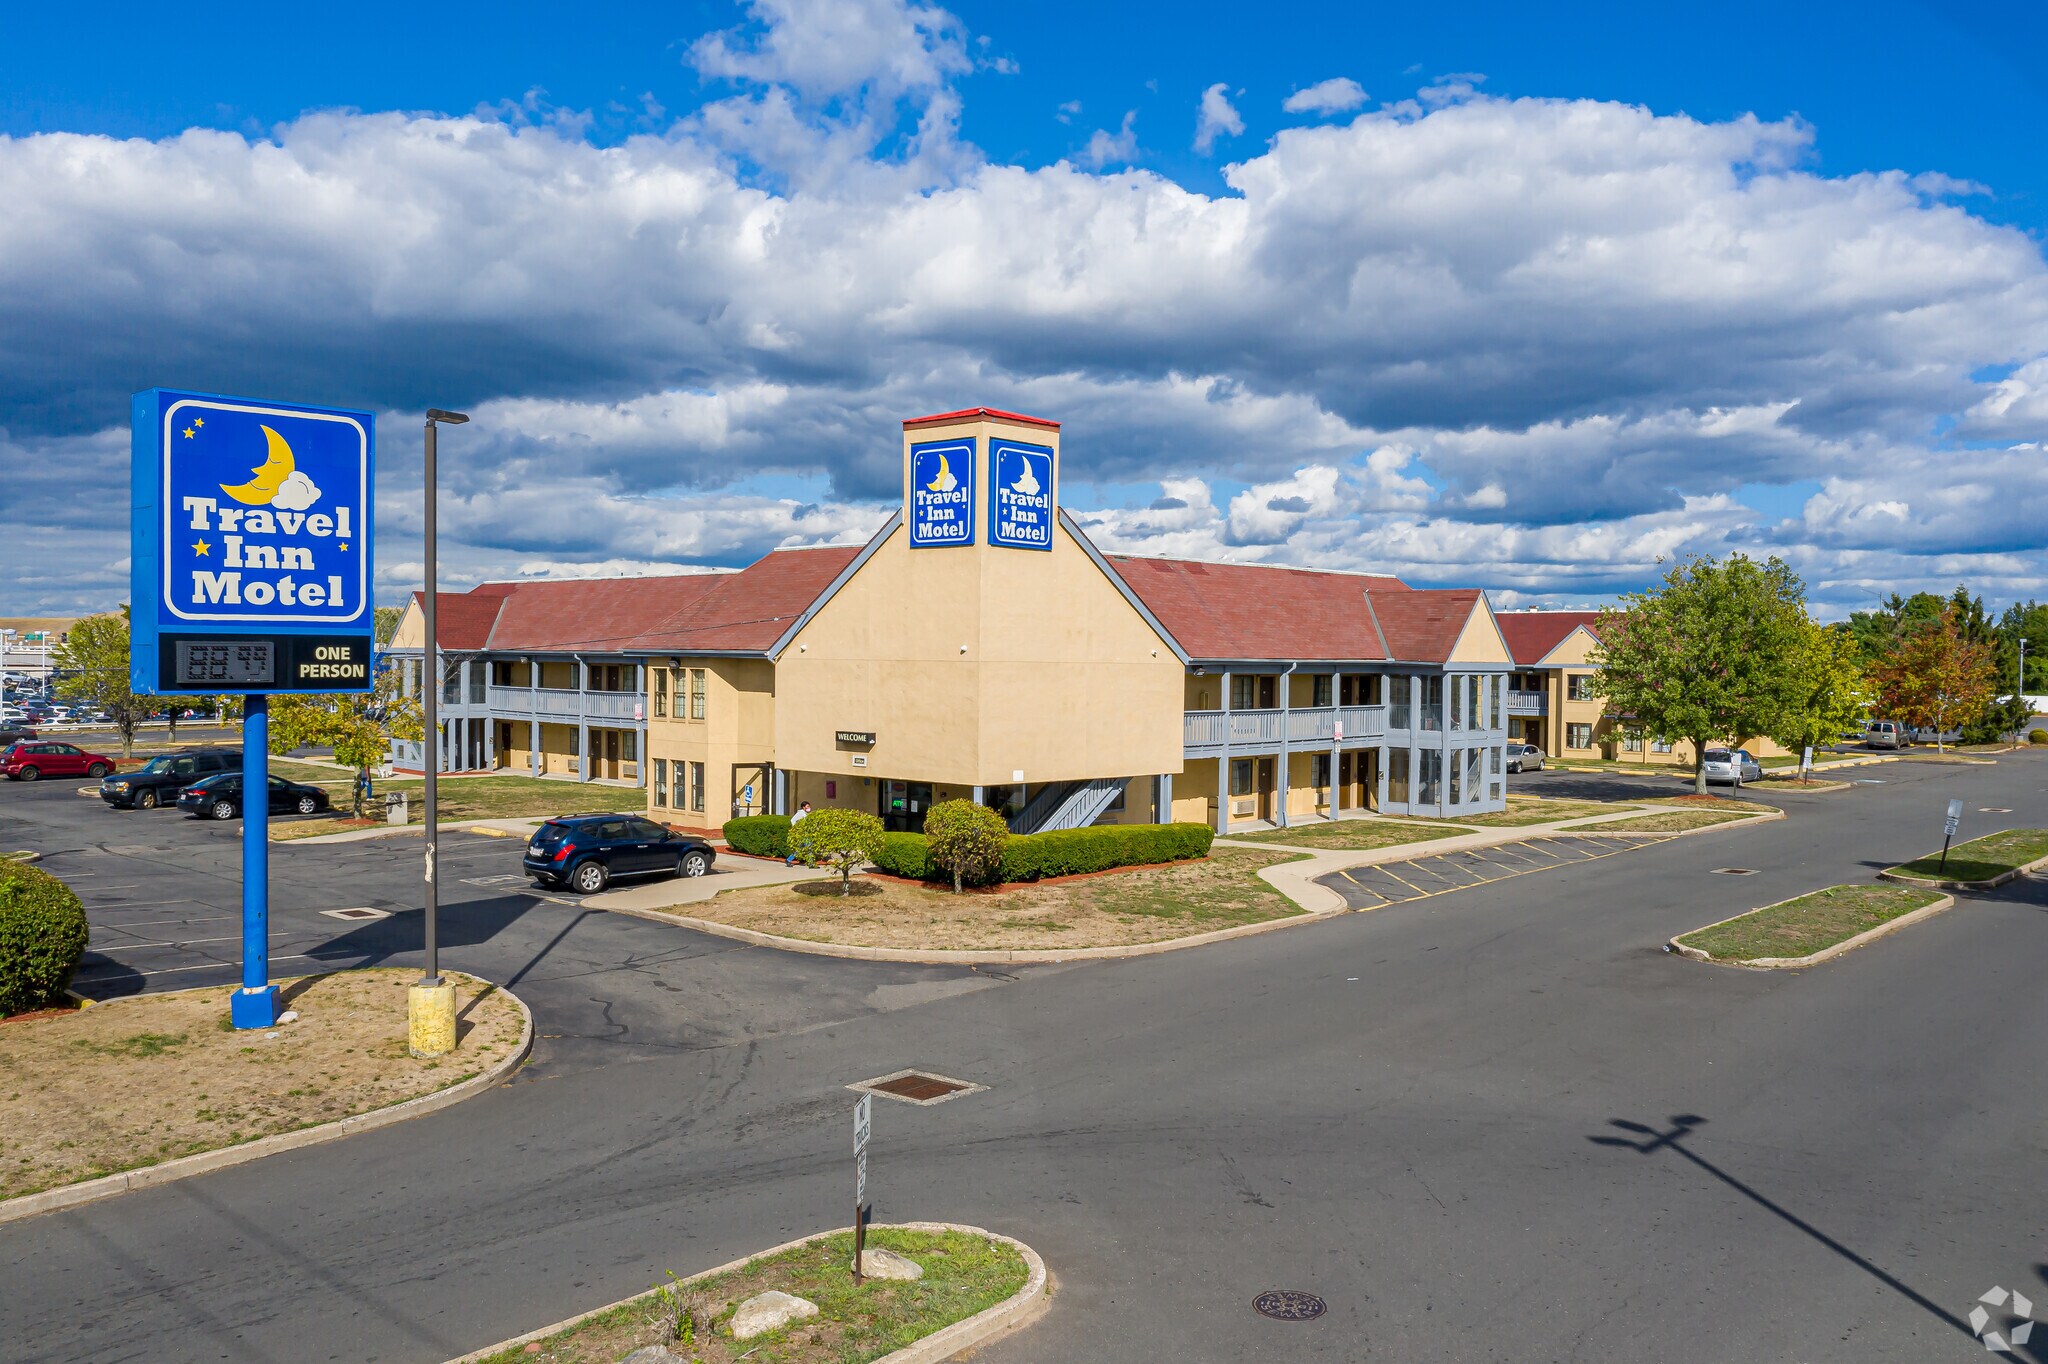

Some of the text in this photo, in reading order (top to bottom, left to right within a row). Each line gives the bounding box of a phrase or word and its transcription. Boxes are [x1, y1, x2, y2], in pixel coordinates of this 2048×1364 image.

[917, 487, 967, 505] Travel
[1000, 488, 1048, 509] Travel
[183, 496, 351, 538] Travel
[927, 506, 955, 521] Inn
[1010, 506, 1037, 523] Inn
[918, 521, 964, 538] Motel
[1001, 522, 1045, 540] Motel
[223, 535, 315, 570] Inn
[192, 570, 344, 607] Motel
[315, 646, 350, 660] ONE
[300, 664, 364, 678] PERSON
[838, 733, 867, 742] WELCOME
[859, 1101, 866, 1124] NO
[856, 1120, 869, 1149] TRUCKS
[1261, 1304, 1315, 1318] SEWER
